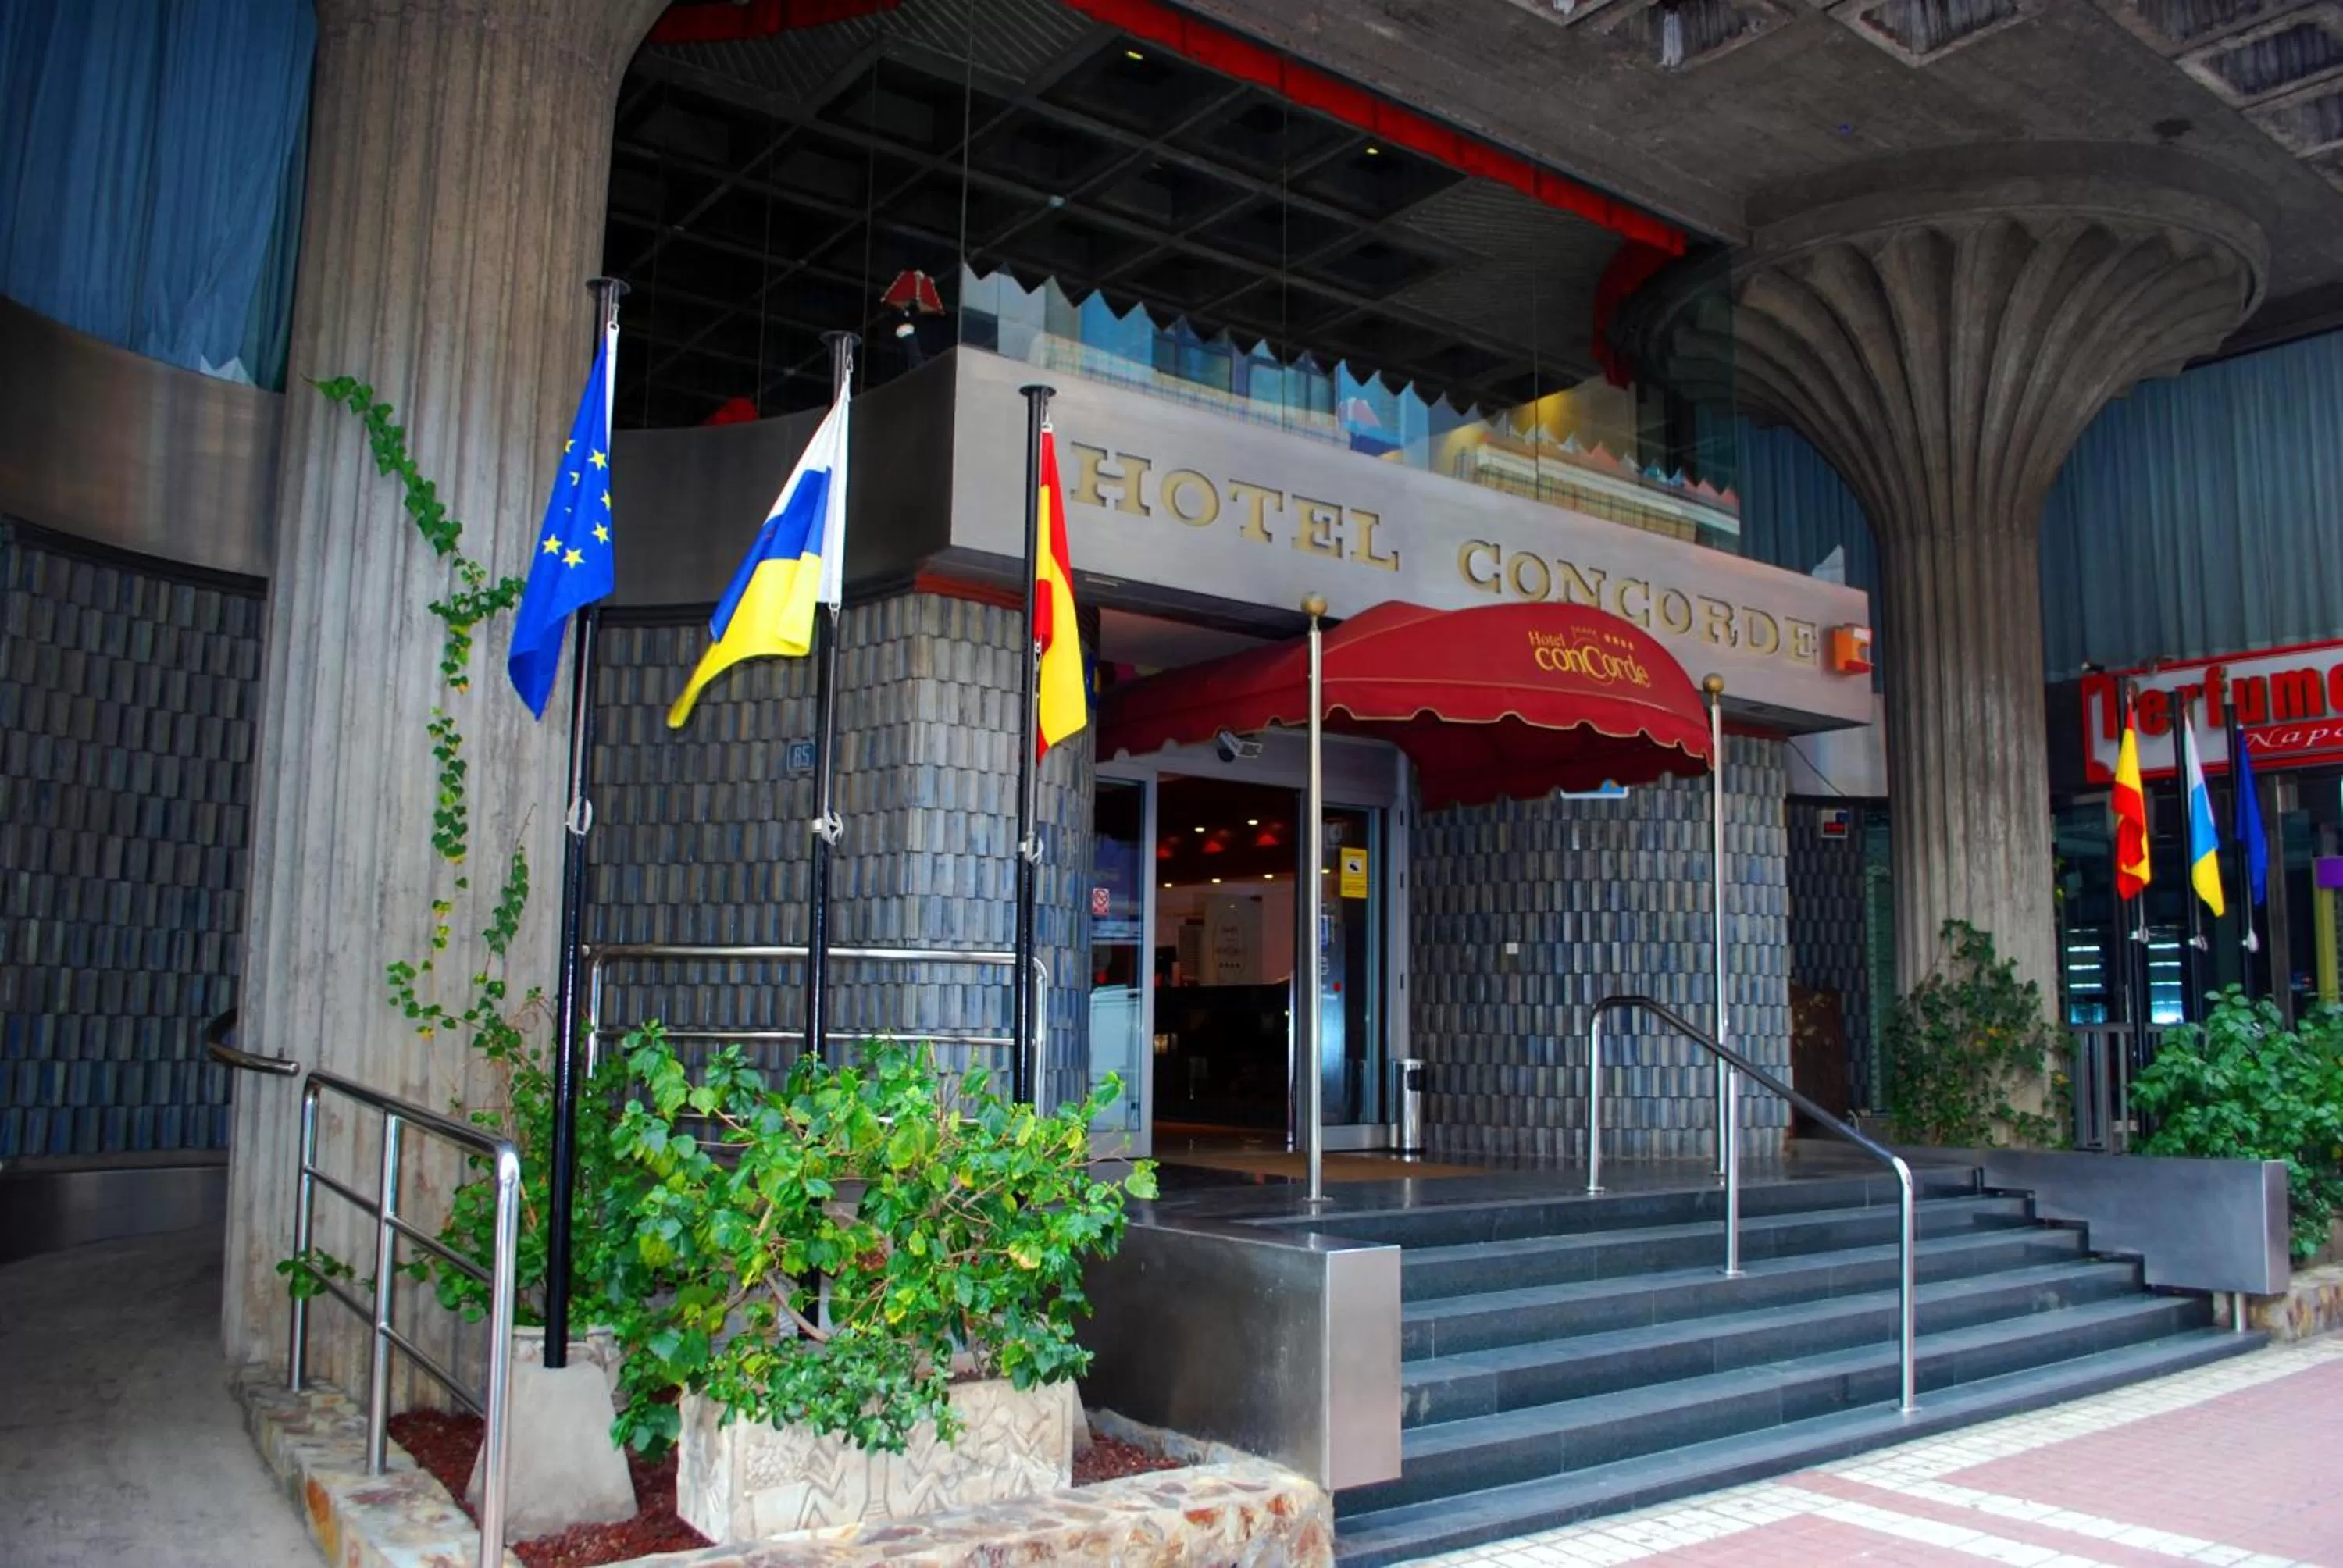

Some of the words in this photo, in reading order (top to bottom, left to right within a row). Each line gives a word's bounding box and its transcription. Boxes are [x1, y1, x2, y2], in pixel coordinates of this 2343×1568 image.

[1071, 441, 1400, 572] HOTEL
[1457, 540, 1817, 667] CONCORDE
[1528, 630, 1566, 647] Hotel
